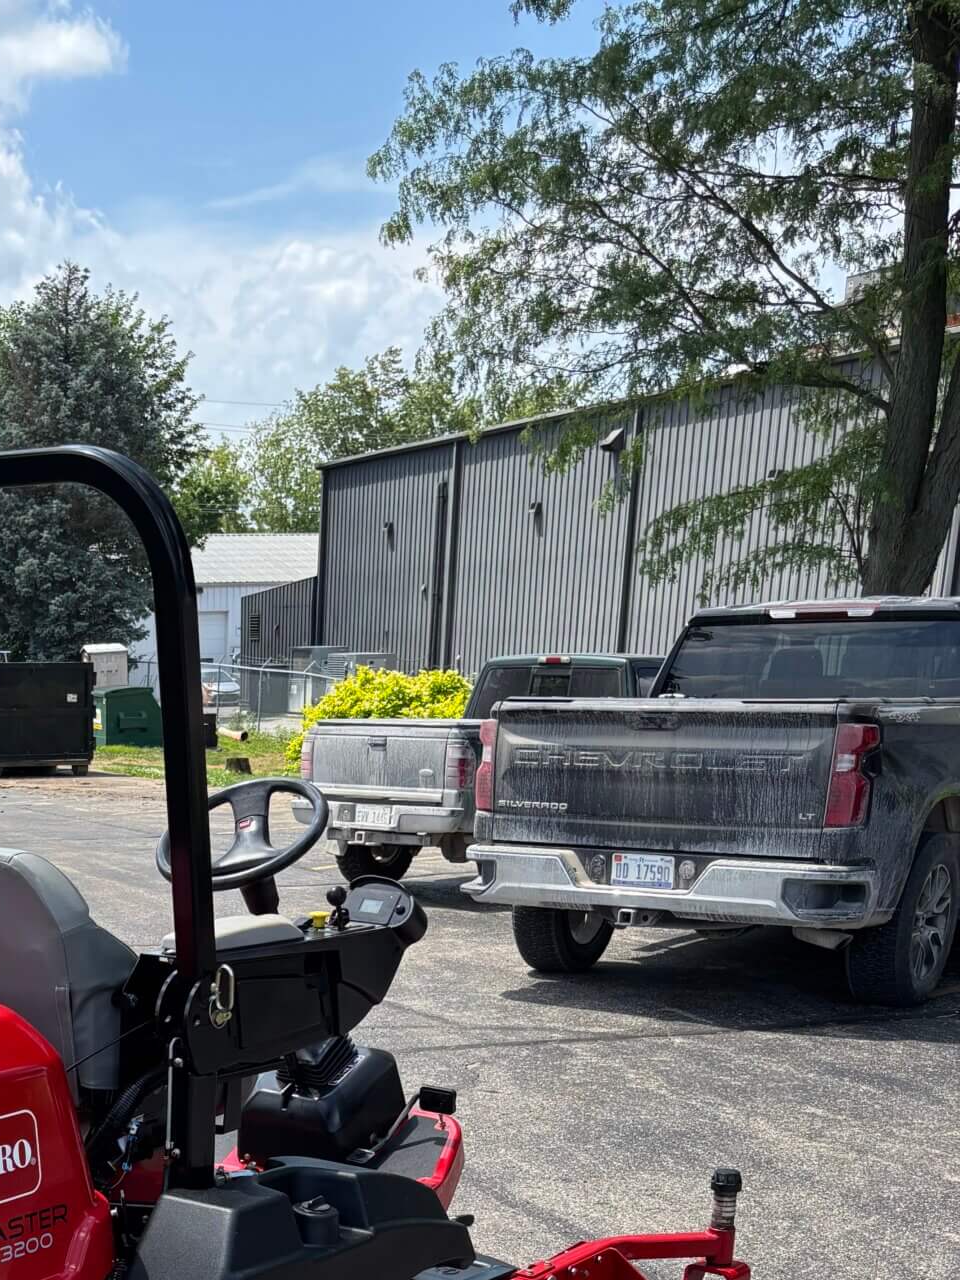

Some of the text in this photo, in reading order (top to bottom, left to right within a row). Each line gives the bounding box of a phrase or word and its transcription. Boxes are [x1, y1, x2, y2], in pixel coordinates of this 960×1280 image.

[512, 747, 809, 772] CHEVROLET
[497, 799, 568, 811] SILVERADO
[798, 812, 816, 820] LT
[636, 863, 671, 882] 17590
[0, 1232, 54, 1264] 3200
